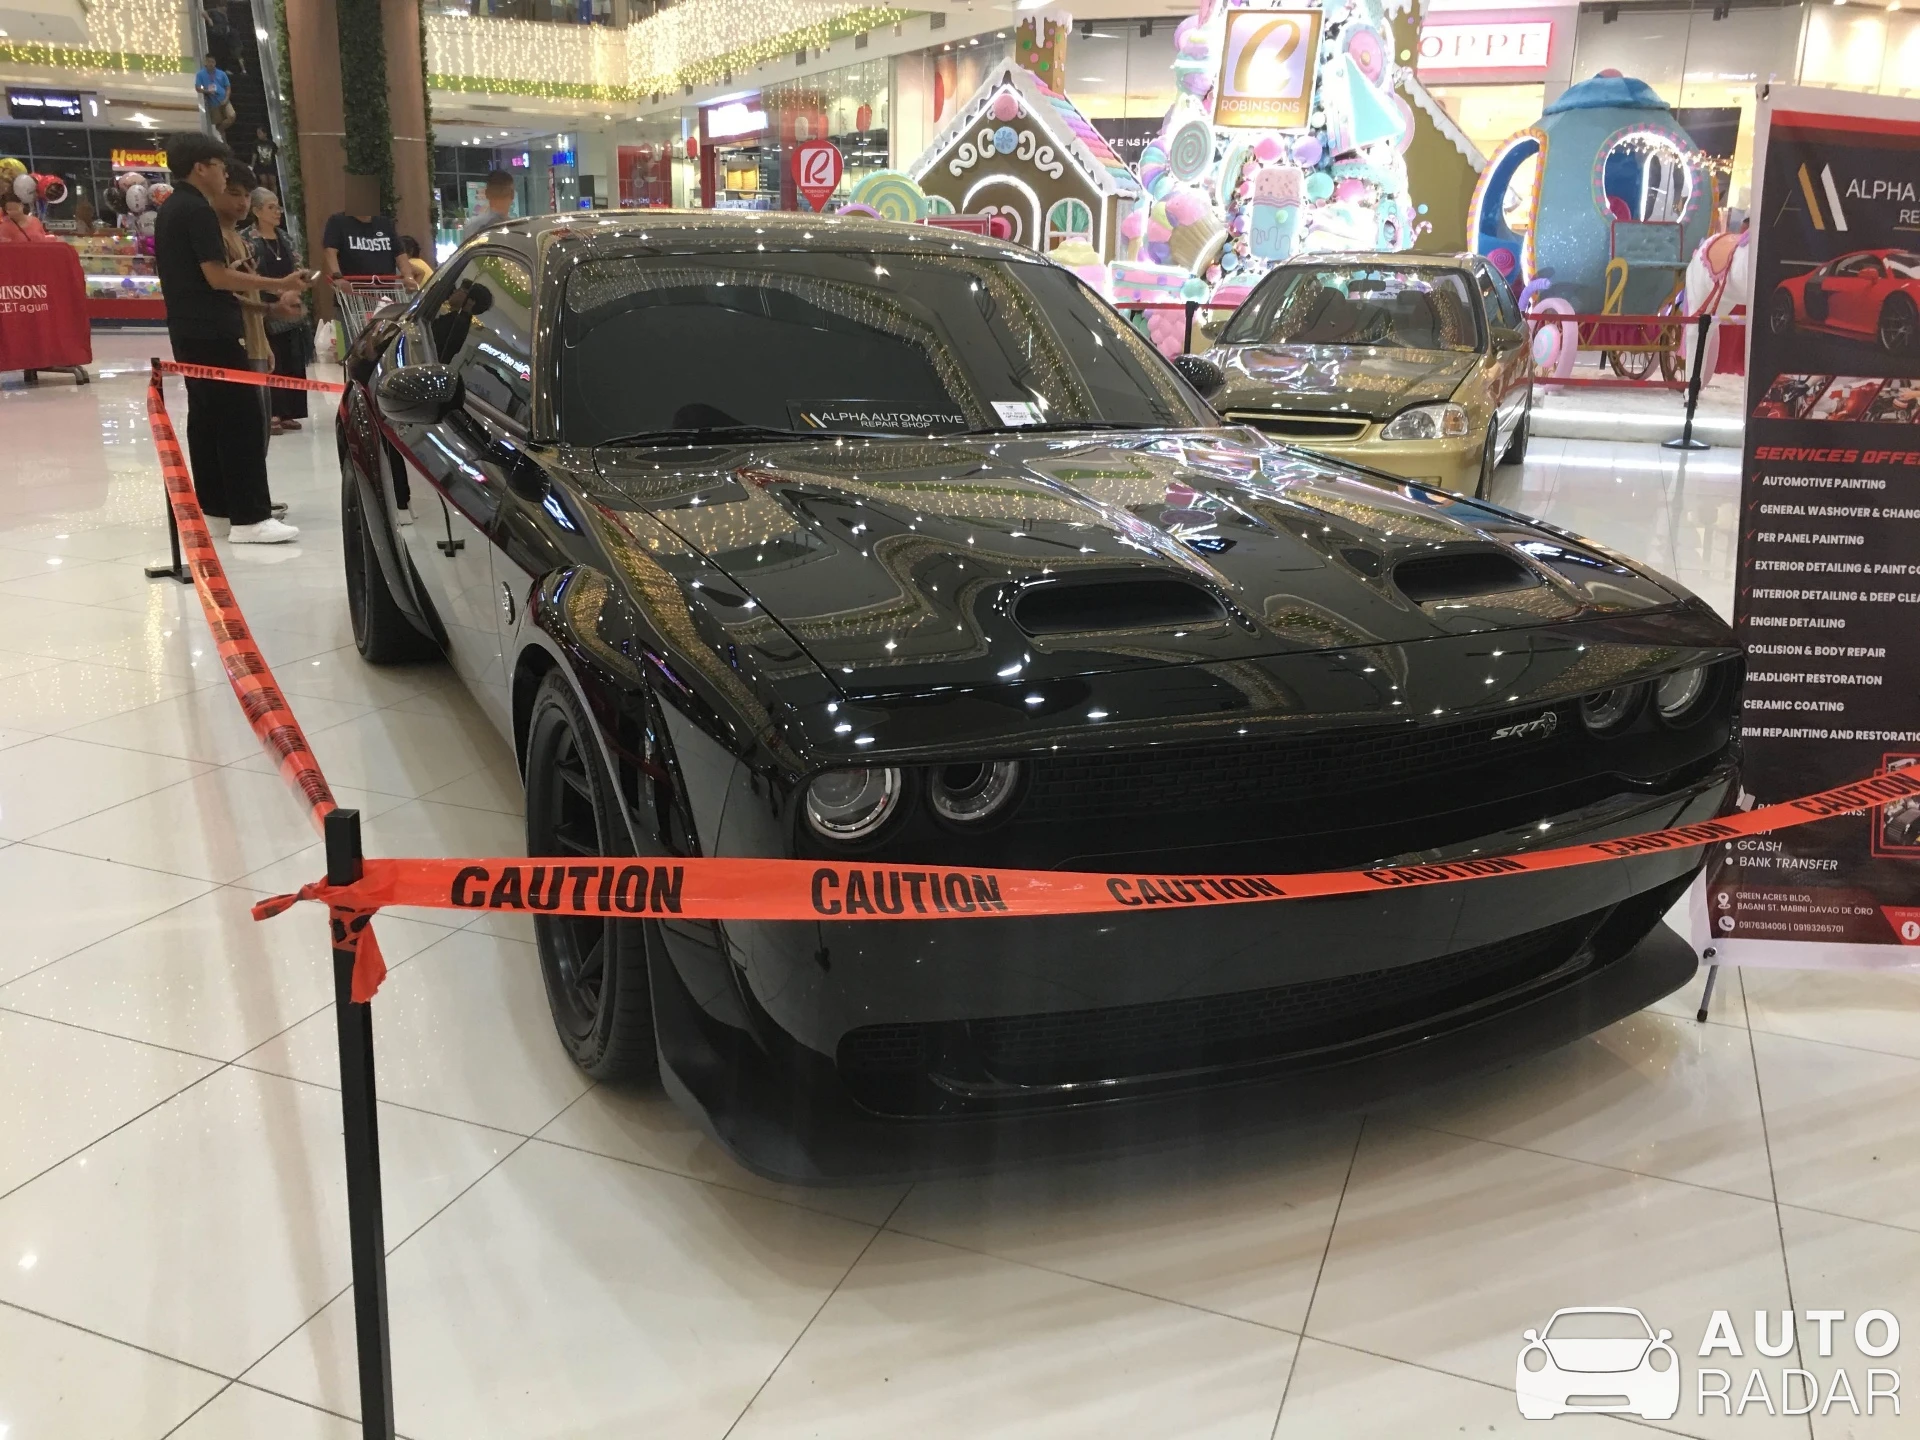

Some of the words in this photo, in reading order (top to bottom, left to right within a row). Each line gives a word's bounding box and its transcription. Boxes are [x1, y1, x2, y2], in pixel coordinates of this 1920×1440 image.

[1221, 100, 1300, 113] ROBINSONS
[1845, 178, 1916, 202] ALPHA
[348, 235, 392, 252] LACOSTE
[0, 285, 47, 300] INSONS
[821, 412, 872, 422] ALPHA
[872, 413, 965, 424] AUTOMOTIVE
[861, 420, 899, 428] REPAIR
[901, 421, 931, 429] SHOP
[1754, 446, 1858, 463] SERVICES
[1762, 476, 1833, 488] AUTOMOTIVE
[1834, 479, 1886, 490] PAINTING
[1760, 505, 1805, 515] GENERAL
[1808, 506, 1870, 518] WASHOVER
[1872, 508, 1880, 518] &
[1757, 532, 1776, 543] PER
[1777, 533, 1811, 544] PANEL
[1812, 534, 1865, 545] PAINTING
[1755, 560, 1805, 572] EXTERIOR
[1806, 562, 1862, 573] DETAILING
[1863, 564, 1872, 574] &
[1874, 564, 1907, 575] PAINT
[1752, 588, 1800, 600] INTERIOR
[1801, 590, 1858, 602] DETAILING
[1859, 592, 1868, 602] &
[1869, 592, 1896, 603] DEEP
[1750, 616, 1788, 627] ENGINE
[1789, 618, 1846, 628] DETAILING
[1748, 644, 1802, 655] COLLISION
[1804, 646, 1813, 656] &
[1814, 646, 1846, 656] BODY
[1847, 647, 1886, 658] REPAIR
[1746, 672, 1805, 683] HEADLIGHT
[1806, 674, 1882, 685] RESTORATION
[1743, 699, 1793, 710] CERAMIC
[1794, 701, 1844, 712] COATING
[1490, 719, 1545, 740] SRT
[1741, 727, 1761, 737] RIM
[1762, 728, 1828, 739] REPAINTING
[1829, 729, 1854, 740] AND
[1790, 774, 1920, 815] CAUTION
[1588, 823, 1740, 854] CAUTION
[1737, 841, 1783, 852] GCASH
[1739, 856, 1771, 868] BANK
[1775, 859, 1838, 871] TRANSFER
[1363, 857, 1527, 887] CAUTION
[451, 866, 684, 914] CAUTION
[811, 868, 1008, 915] CAUTION
[1106, 877, 1286, 906] CAUTION
[1736, 892, 1761, 900] GREEN
[1762, 893, 1788, 902] ACRES
[1737, 903, 1766, 911] BAGANI
[1767, 903, 1779, 911] ST.
[1780, 904, 1808, 913] MABINI
[1809, 905, 1839, 914] DAVAO
[1841, 906, 1852, 914] DE
[1854, 907, 1874, 916] ORO
